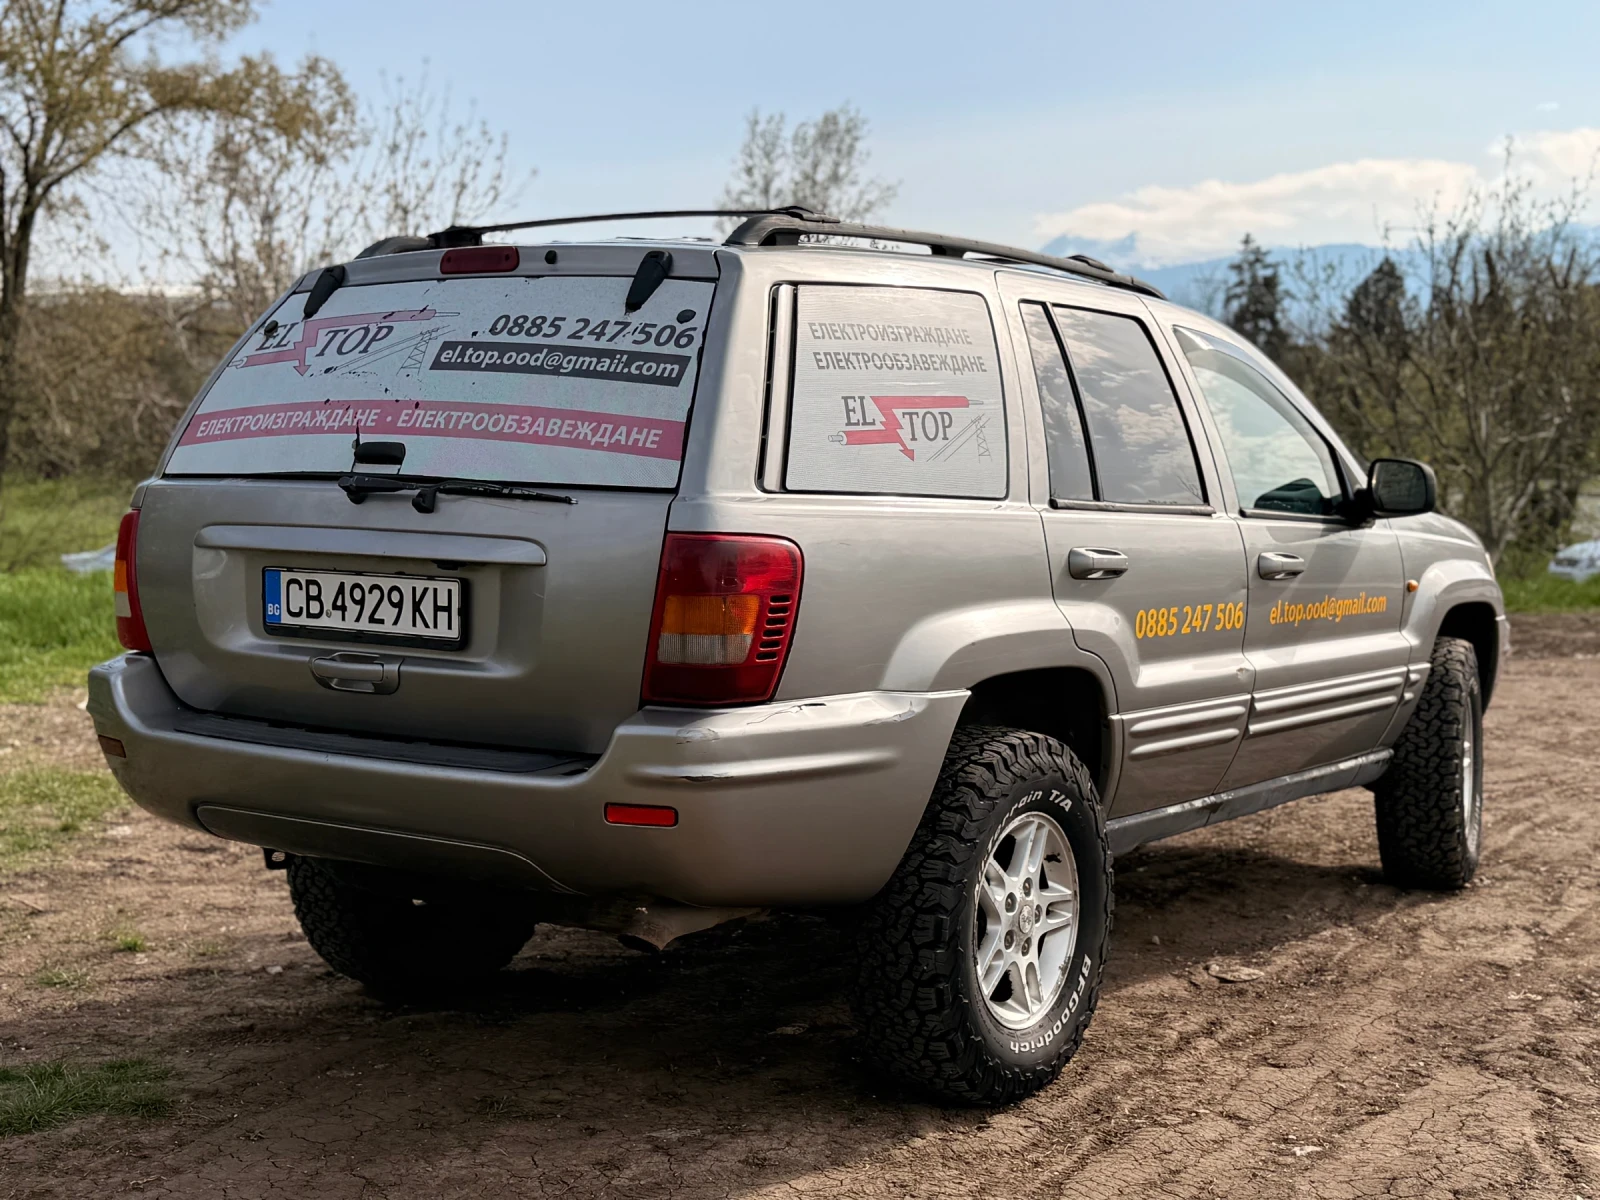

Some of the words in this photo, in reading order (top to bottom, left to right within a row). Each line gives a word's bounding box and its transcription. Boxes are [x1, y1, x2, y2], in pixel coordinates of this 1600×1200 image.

[255, 322, 299, 351] EL
[315, 325, 394, 357] TOP
[490, 314, 566, 338] 0885
[567, 318, 632, 343] 247
[632, 323, 698, 349] 506
[807, 322, 973, 347] ЕЛЕКТРОИЗГРАЖДАНЕ
[440, 345, 680, 378] el.top.ood@gmail.com
[813, 352, 987, 375] ЕЛЕКТРООБЗАВЕЖДАНЕ
[196, 409, 381, 437] ЕЛЕКТРОИЗГРАЖДАНЕ
[397, 410, 663, 449] ЕЛЕКТРООБЗАВЕЖДАНЕ
[841, 395, 876, 426] EL
[902, 411, 953, 442] TOP
[267, 603, 280, 616] BG
[1135, 607, 1178, 639] 0885
[1181, 604, 1213, 635] 247
[1215, 602, 1244, 631] 506
[1269, 592, 1387, 627] el.top.ood@gmail.com
[1048, 789, 1073, 812] T/A
[1010, 953, 1092, 1054] BFGoodrich
